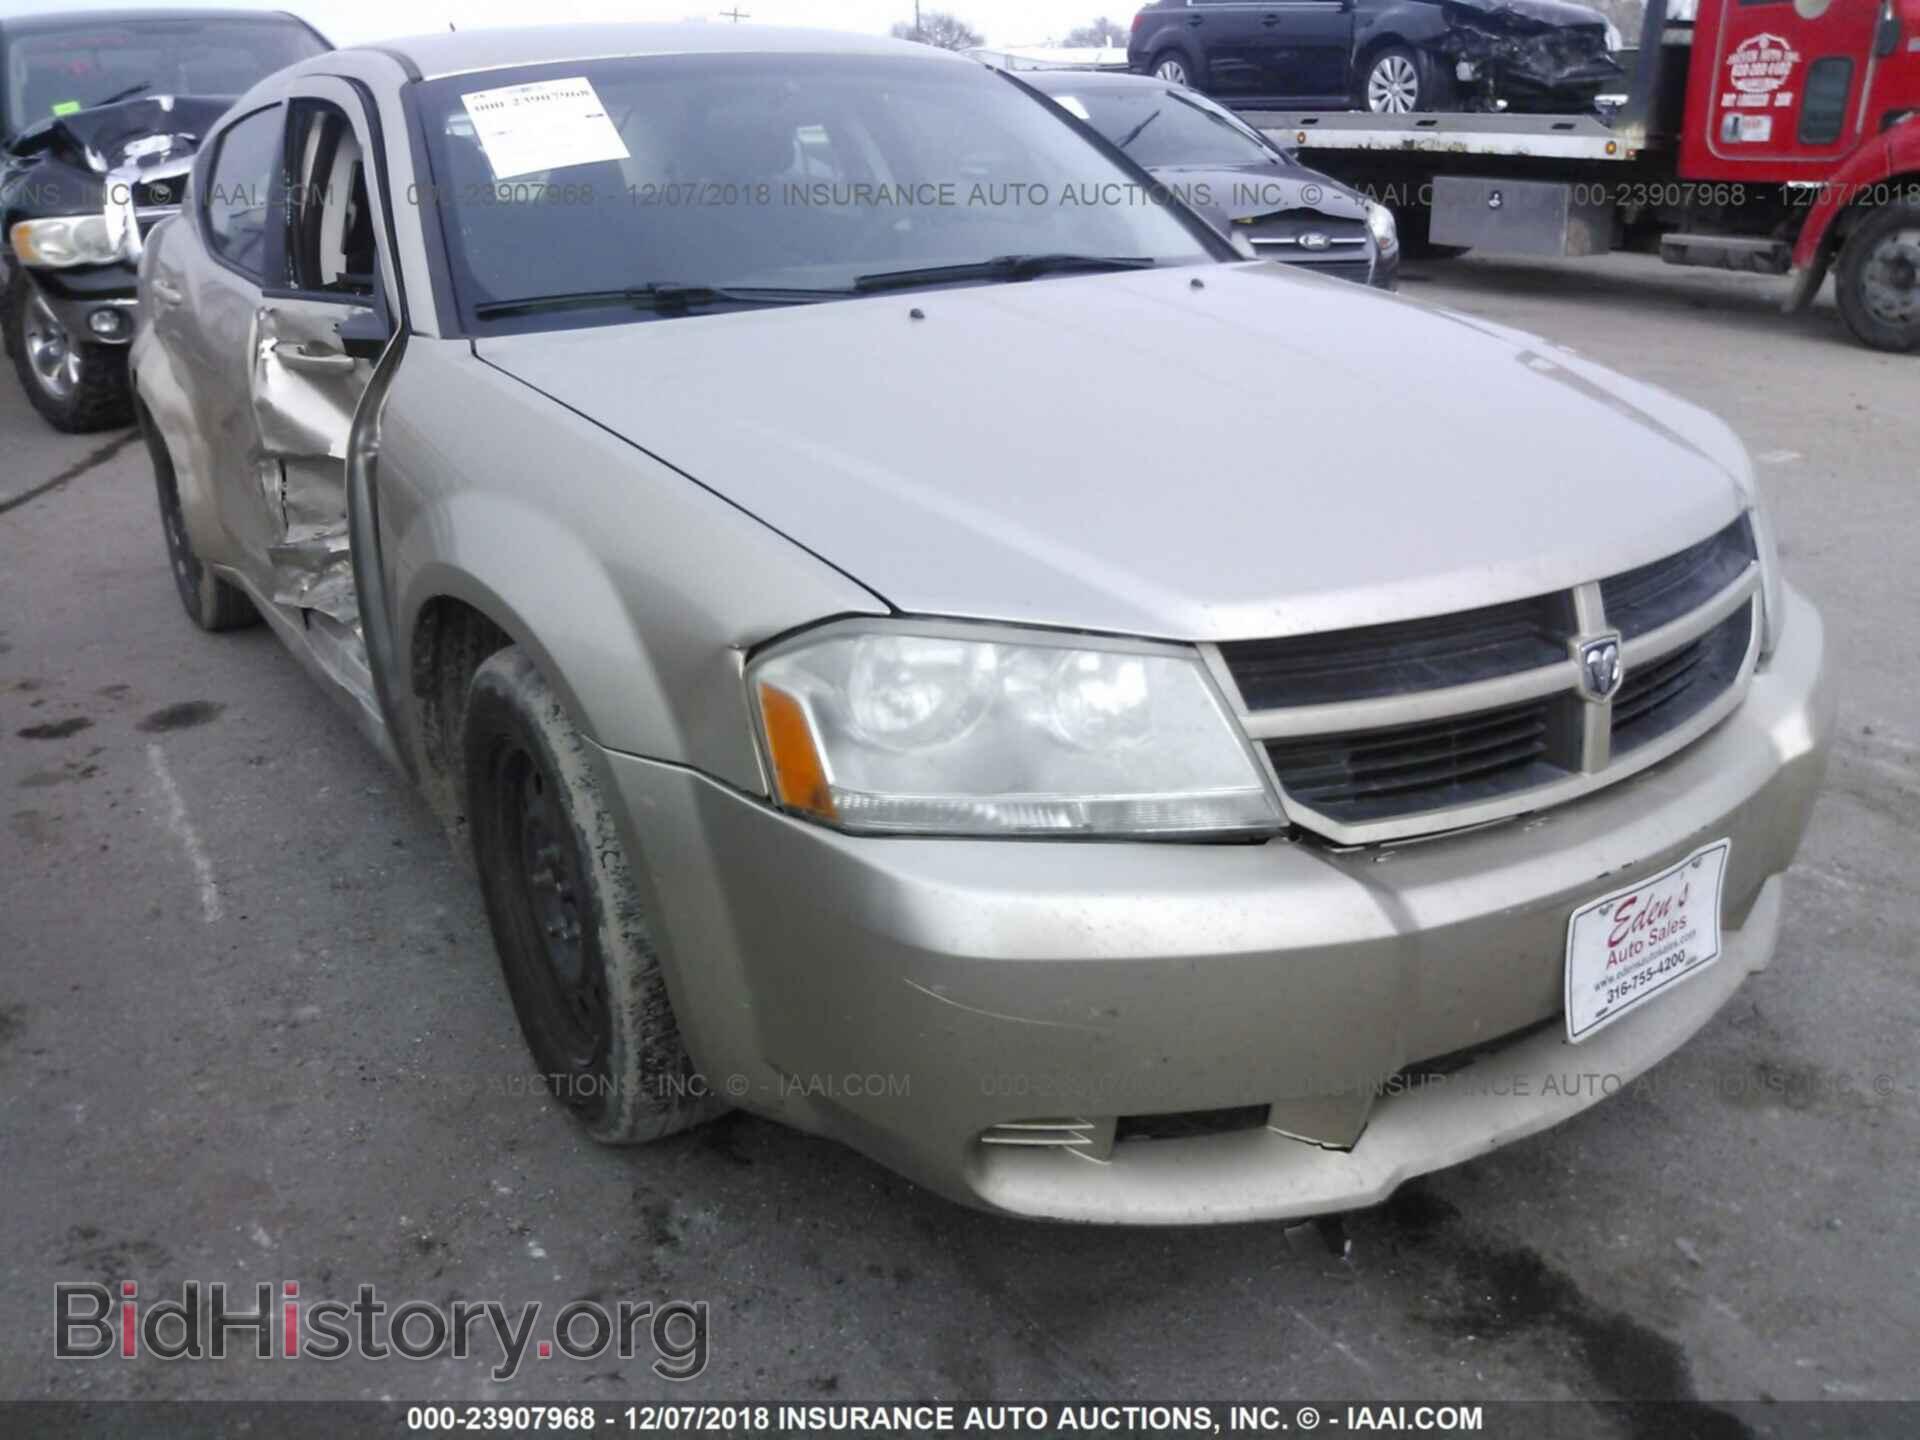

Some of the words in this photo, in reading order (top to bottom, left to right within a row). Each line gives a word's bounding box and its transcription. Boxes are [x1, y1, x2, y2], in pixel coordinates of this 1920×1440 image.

[1606, 872, 1689, 949] Eden's
[1606, 940, 1645, 971] Auto
[1648, 915, 1688, 948] Sales
[1607, 950, 1687, 1005] 316-755-4200
